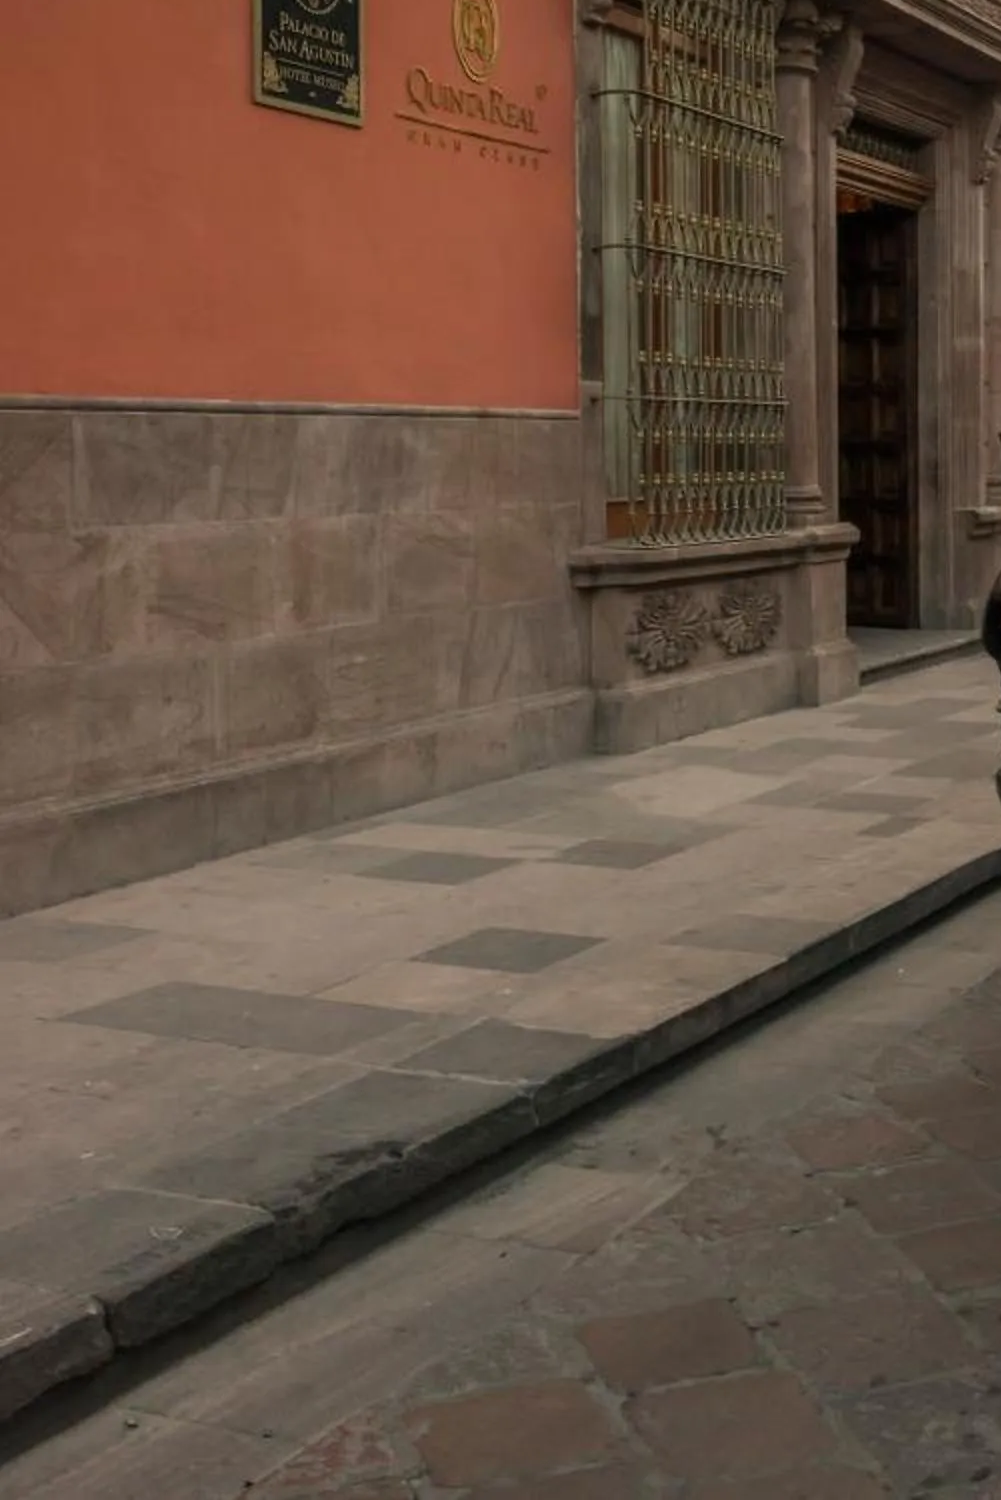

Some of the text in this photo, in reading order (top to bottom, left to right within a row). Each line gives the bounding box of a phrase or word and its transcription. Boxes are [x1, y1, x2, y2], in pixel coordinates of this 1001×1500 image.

[269, 29, 297, 53] SAN
[280, 11, 345, 46] PALACIO DE
